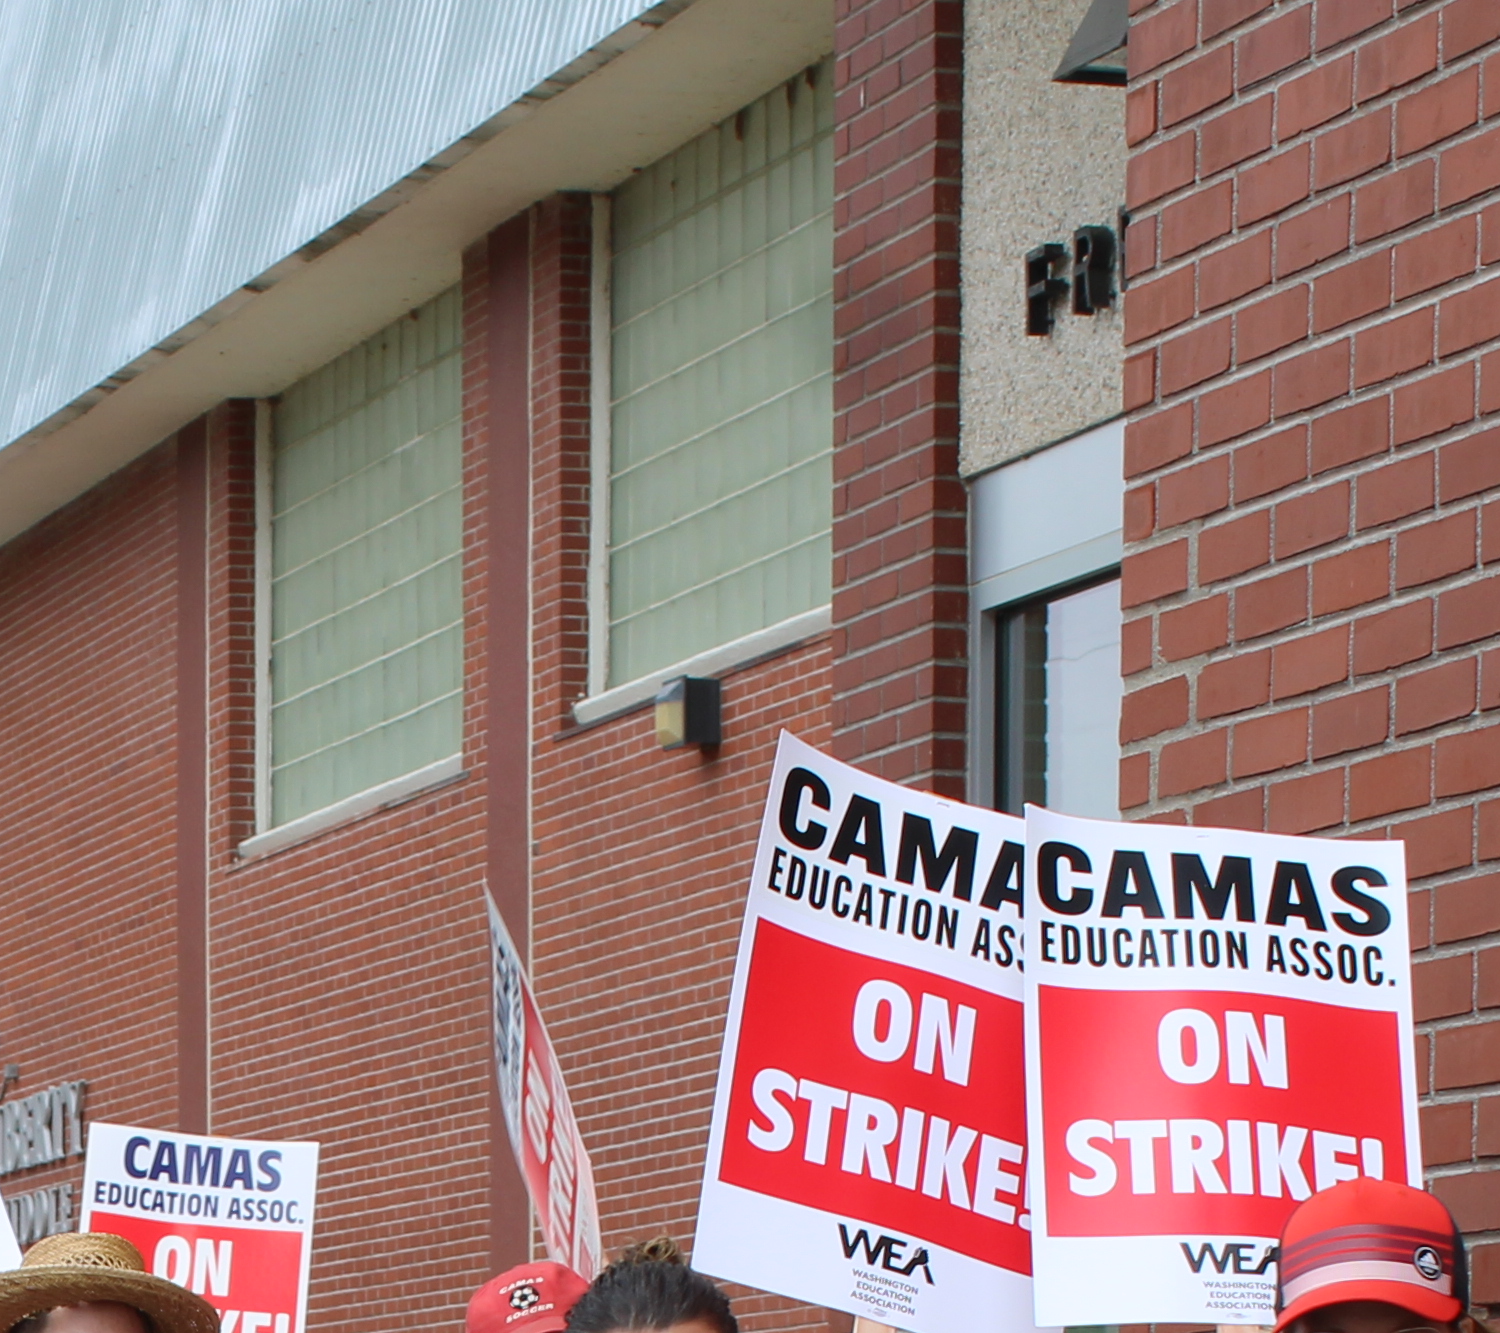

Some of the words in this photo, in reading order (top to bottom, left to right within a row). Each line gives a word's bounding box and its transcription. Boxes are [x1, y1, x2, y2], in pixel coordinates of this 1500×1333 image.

[1025, 205, 1130, 336] FR
[778, 766, 1025, 920] CAMA
[767, 847, 957, 951] EDUCATION
[1036, 840, 1393, 937] CAMAS
[1039, 921, 1250, 973] EDUCATION
[1267, 934, 1397, 988] ASSOC.
[851, 979, 976, 1087] ON
[1155, 1008, 1289, 1090] ON
[123, 1135, 282, 1192] CAMAS
[94, 1181, 219, 1216] EDUCATION
[228, 1198, 304, 1225] ASSOC.
[152, 1235, 231, 1296] ON
[837, 1222, 935, 1286] WEA
[852, 1268, 919, 1295] WASHINGTON
[499, 1277, 544, 1295] CAMAS
[506, 1303, 554, 1324] SOCCER
[850, 1291, 916, 1316] ASSOCIATION
[856, 1281, 912, 1304] EDUCATION
[1203, 1281, 1276, 1290] WASHINGTON
[1210, 1291, 1271, 1300] EDUCATION
